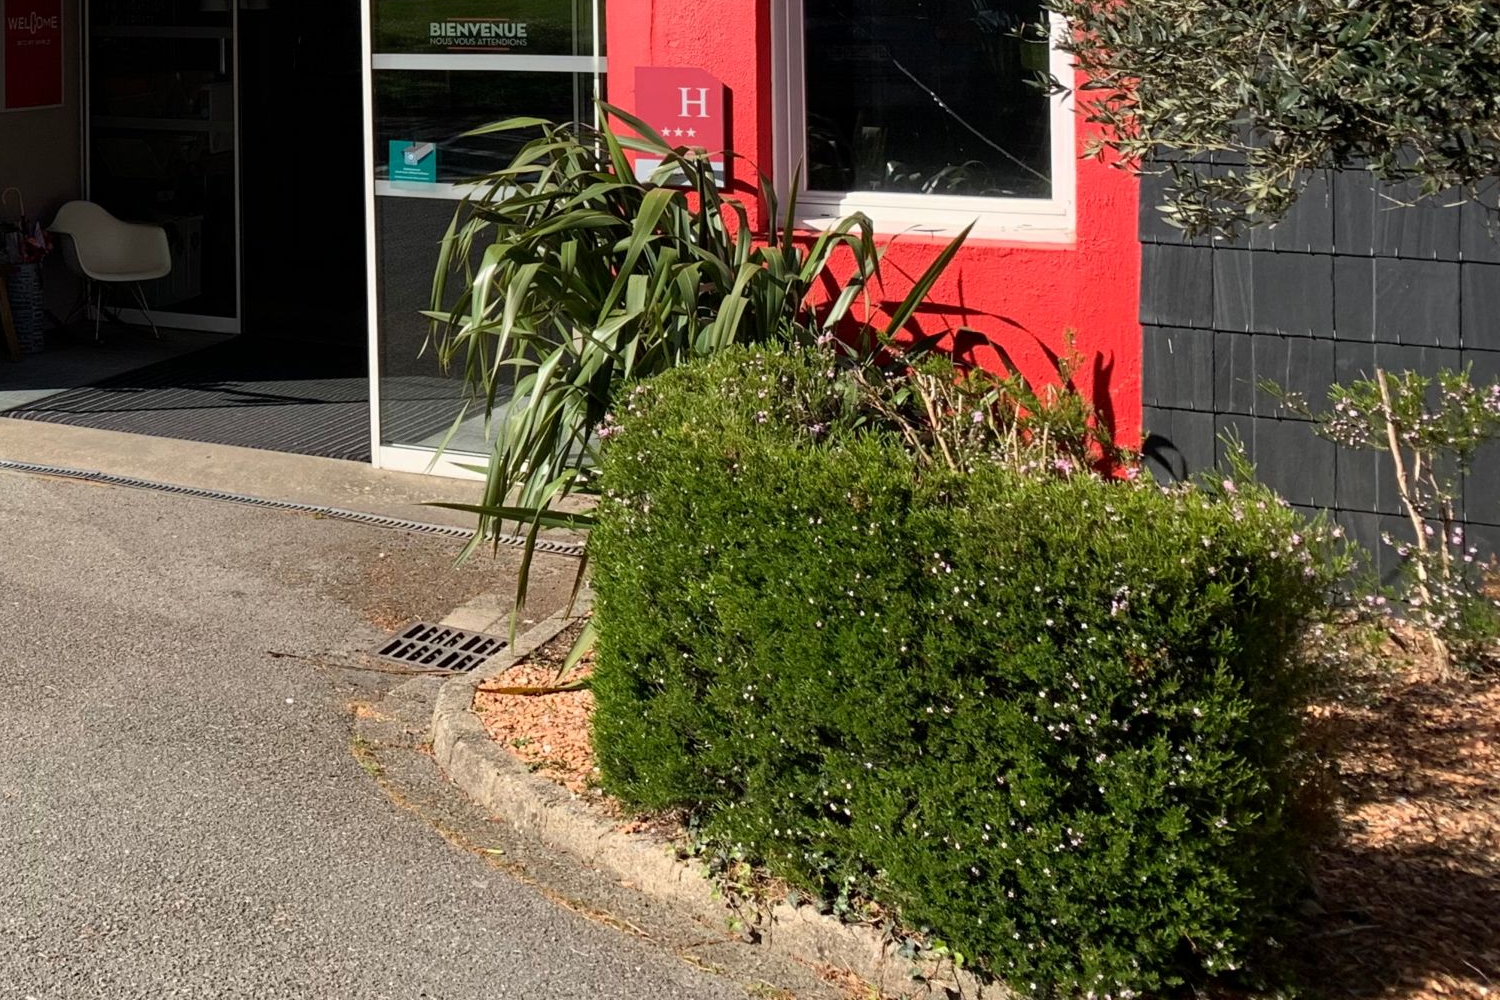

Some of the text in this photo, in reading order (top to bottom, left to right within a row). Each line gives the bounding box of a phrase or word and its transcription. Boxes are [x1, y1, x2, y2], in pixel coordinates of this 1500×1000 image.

[7, 11, 59, 35] WELCOME
[429, 22, 528, 37] BIENVENUE
[430, 37, 528, 47] NOUS VOUS ATTENDIONS
[677, 87, 711, 118] H
